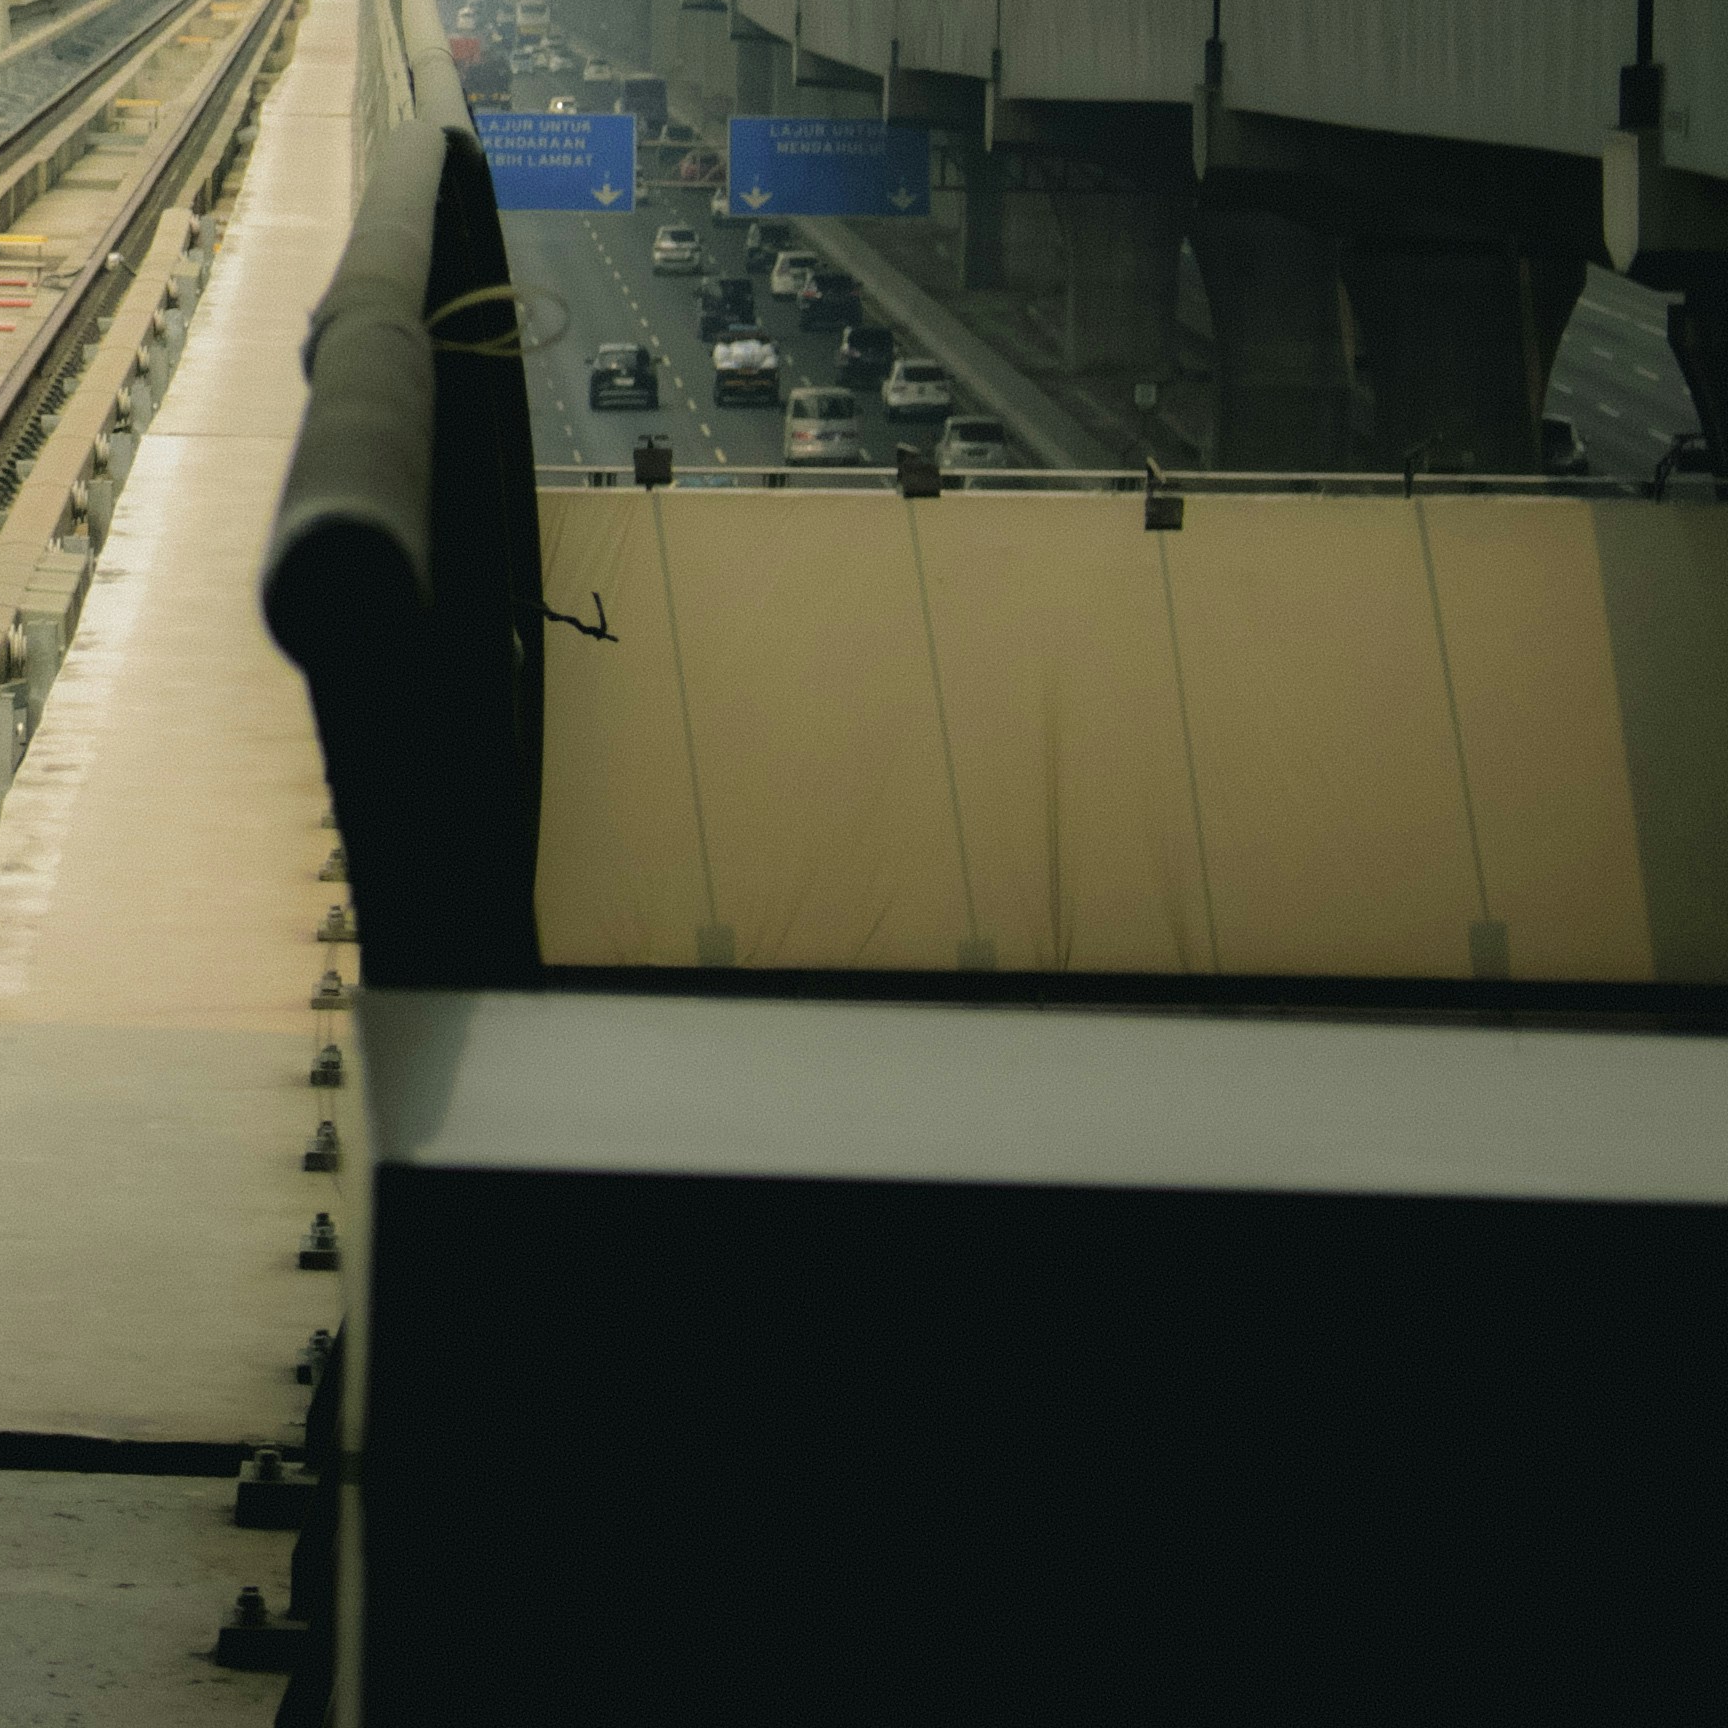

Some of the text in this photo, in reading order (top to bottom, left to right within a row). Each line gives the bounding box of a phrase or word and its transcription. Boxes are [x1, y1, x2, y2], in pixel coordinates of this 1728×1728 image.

[477, 119, 591, 133] LAJUR UNTUK
[769, 124, 825, 137] LAJUR
[482, 136, 585, 150] KENDARAAN
[528, 154, 593, 167] LAMBAT
